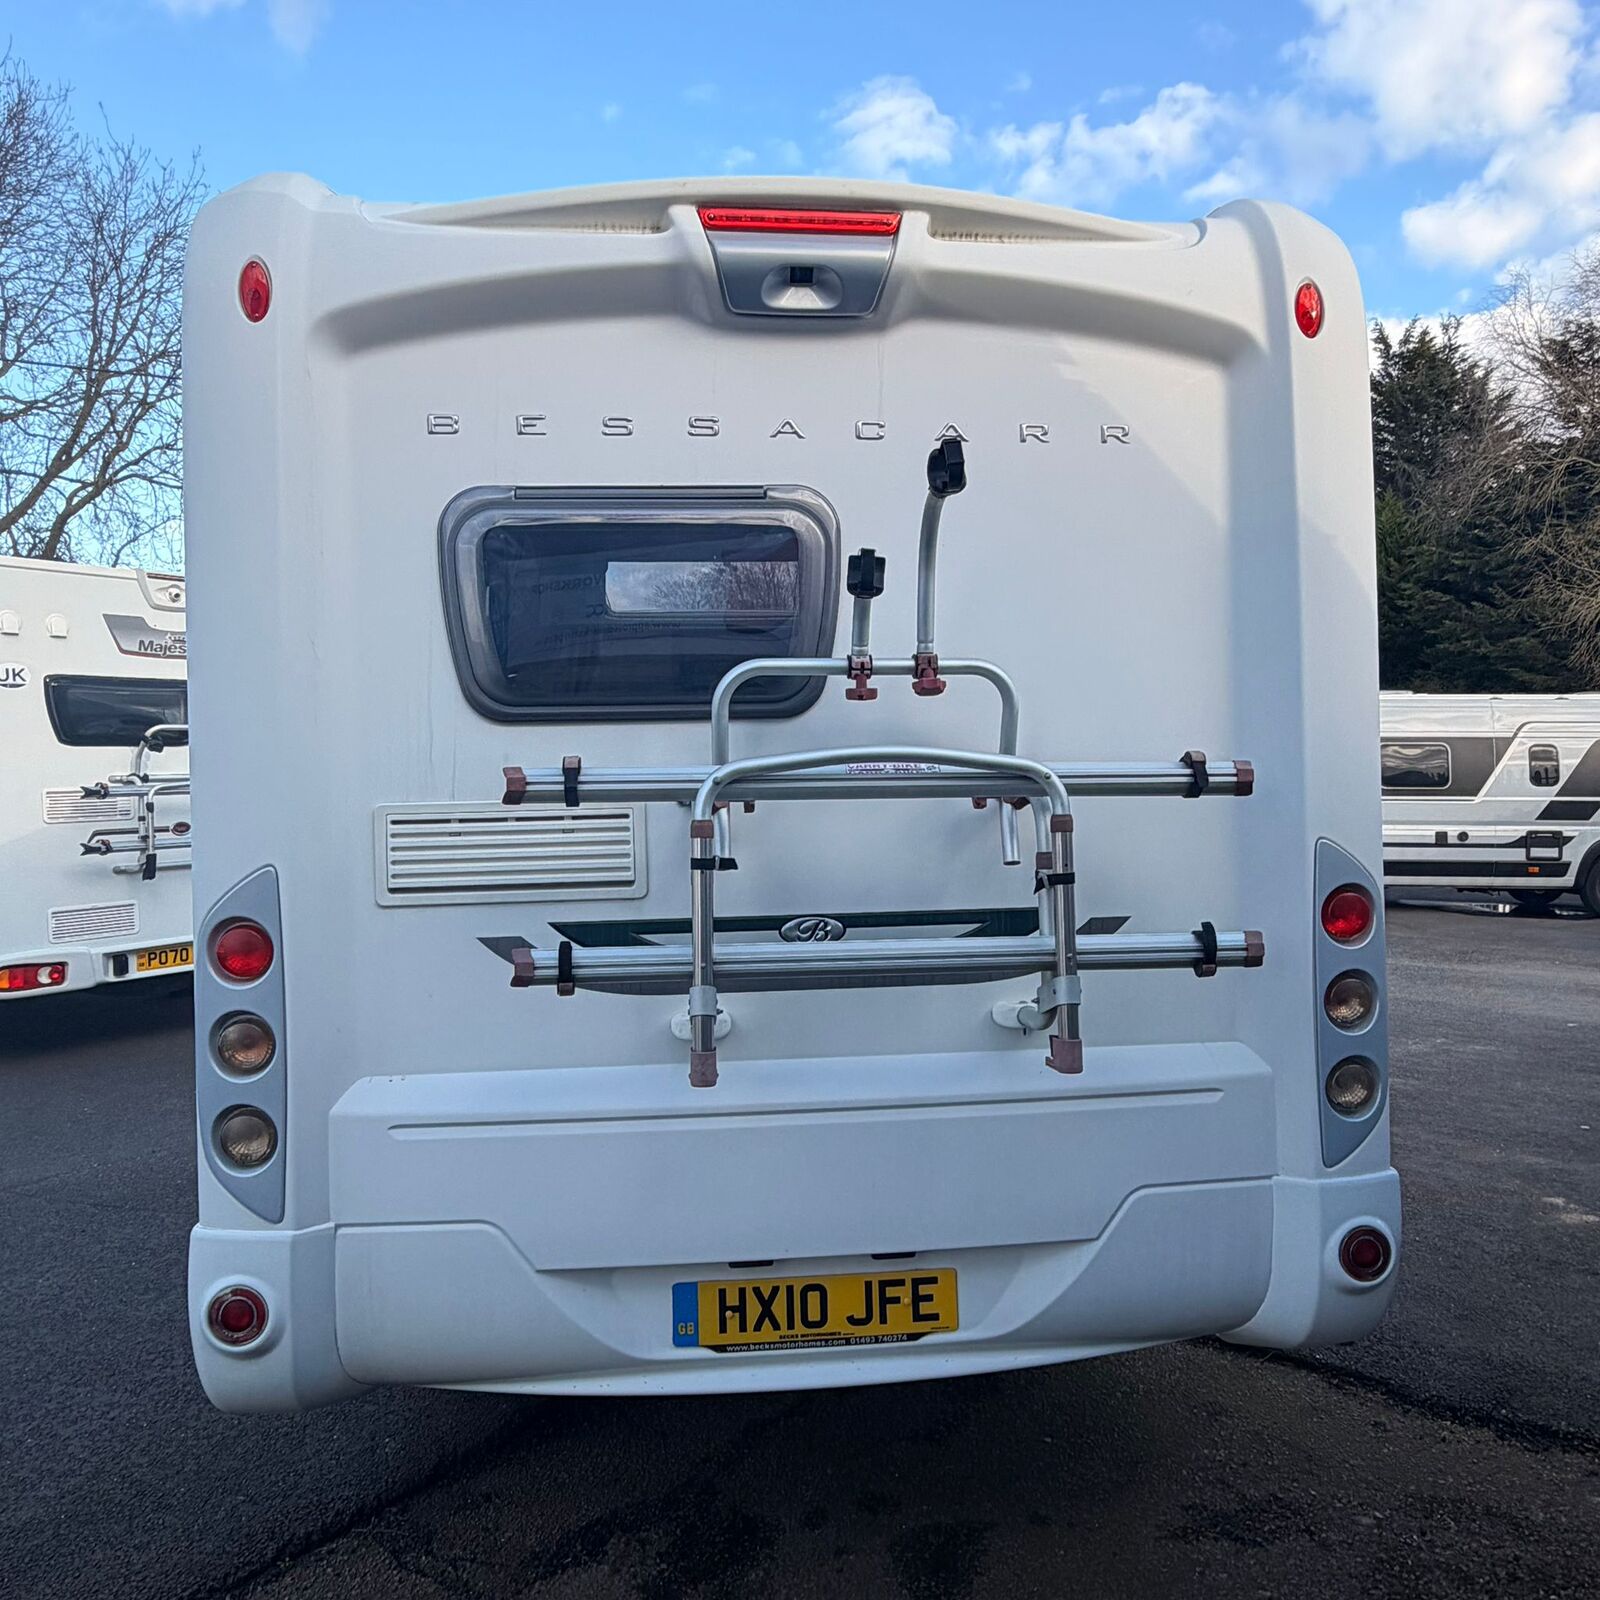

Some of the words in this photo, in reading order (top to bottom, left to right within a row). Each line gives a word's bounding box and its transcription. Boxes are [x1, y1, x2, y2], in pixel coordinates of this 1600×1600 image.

[426, 413, 1131, 444] BESSACARR
[718, 1282, 828, 1335] HX10
[846, 1276, 940, 1327] JFE
[677, 1322, 695, 1336] GB
[726, 1338, 846, 1352] www.becksmotorhomes.com
[850, 1335, 876, 1345] 01493
[878, 1334, 908, 1343] 740274
